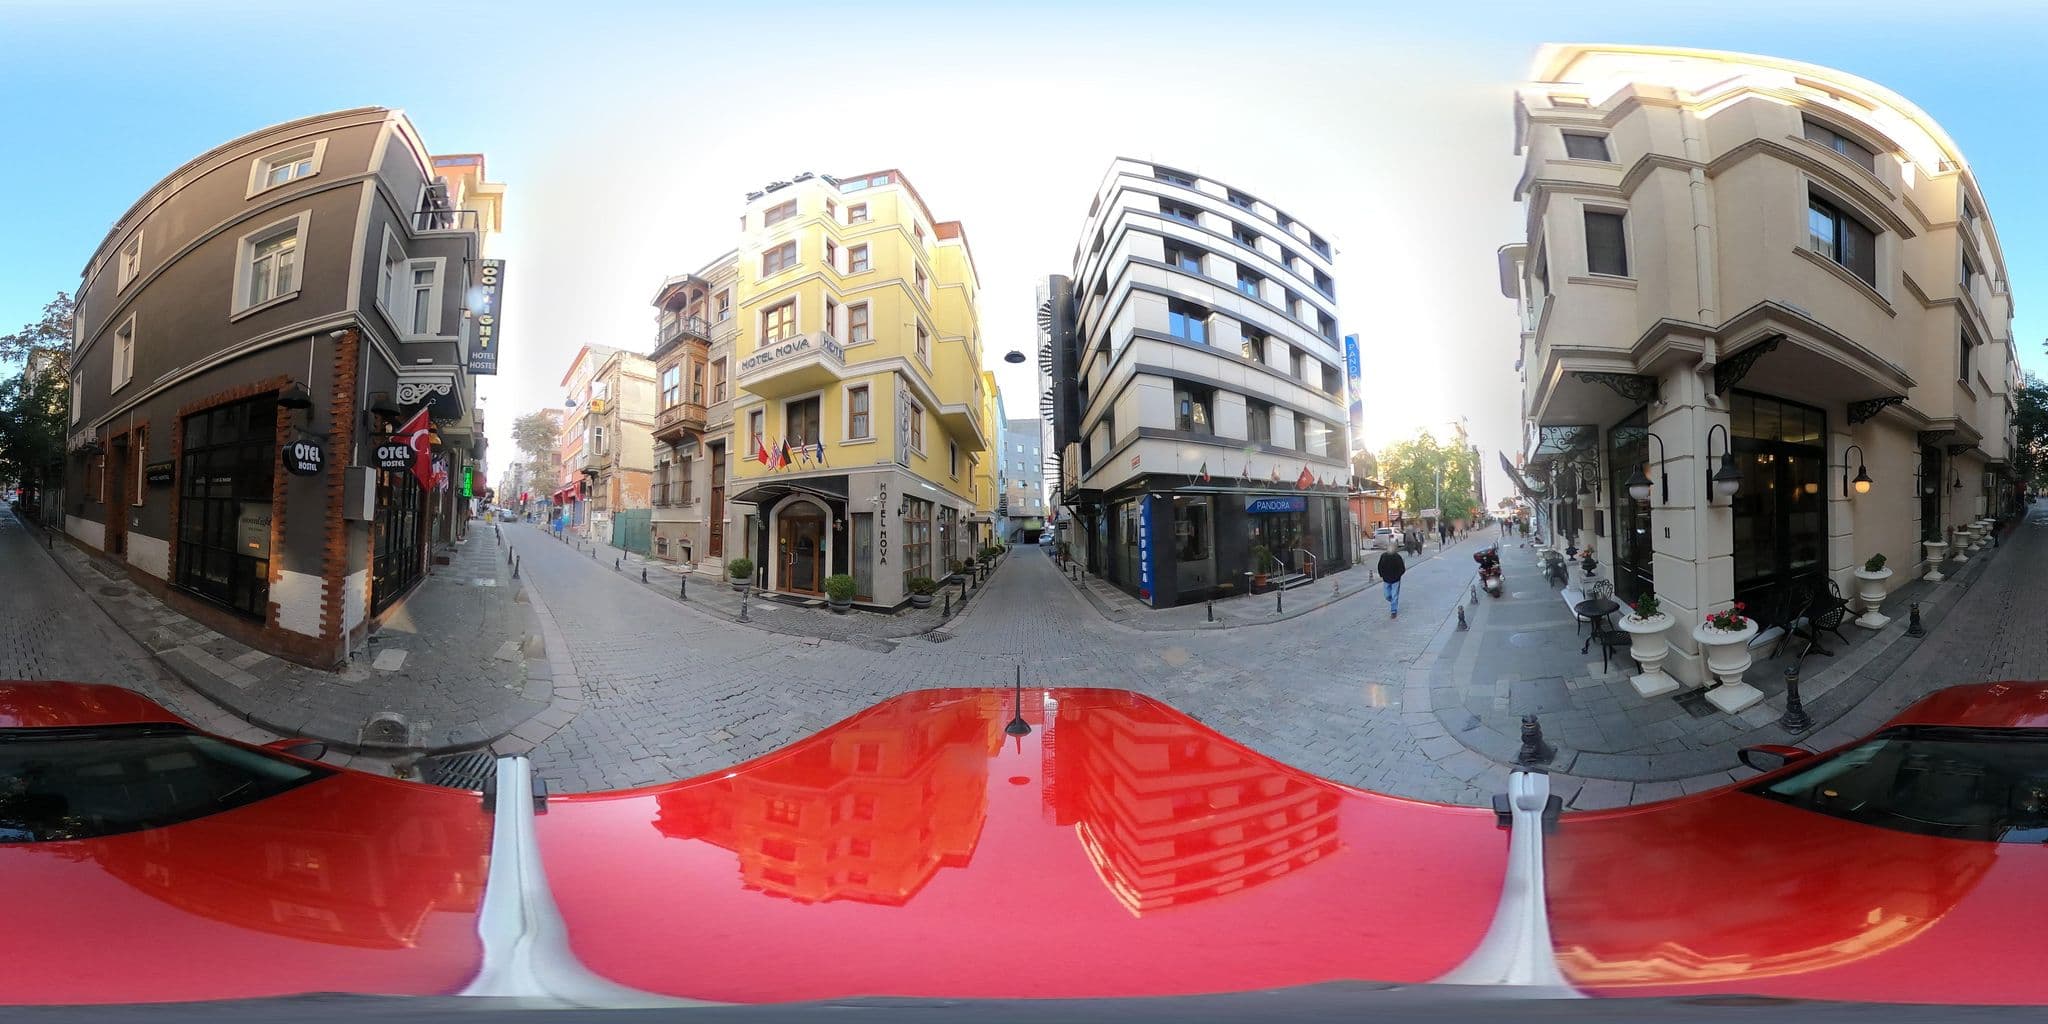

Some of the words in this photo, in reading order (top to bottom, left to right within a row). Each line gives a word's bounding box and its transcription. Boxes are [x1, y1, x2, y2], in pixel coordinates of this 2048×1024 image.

[478, 260, 499, 348] MOONLIGHT
[472, 352, 495, 360] HOTEL
[742, 352, 773, 370] HOTEL
[775, 338, 810, 358] NOVA
[469, 361, 497, 370] HOSTEL
[294, 443, 321, 463] OTEL
[377, 446, 410, 460] OTEL
[298, 461, 318, 472] HOSTEL
[381, 460, 405, 468] HOSTEL
[1256, 501, 1290, 510] PANDORA
